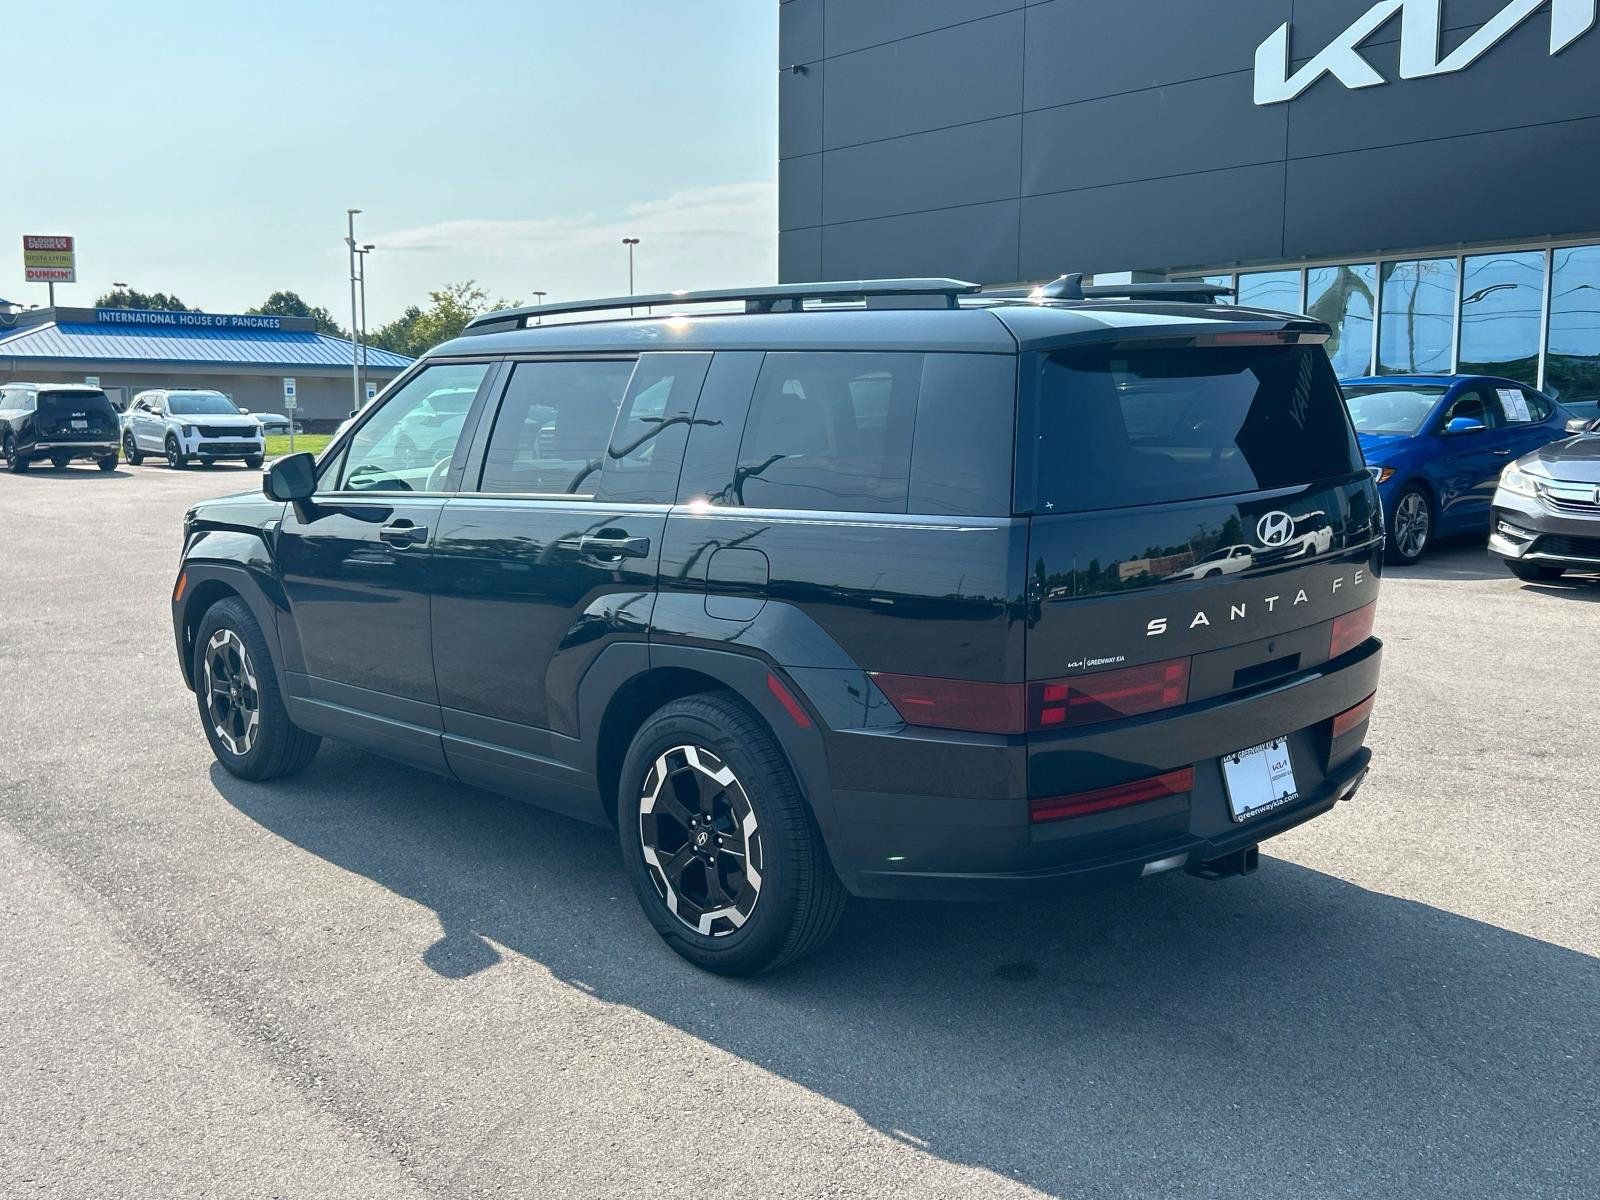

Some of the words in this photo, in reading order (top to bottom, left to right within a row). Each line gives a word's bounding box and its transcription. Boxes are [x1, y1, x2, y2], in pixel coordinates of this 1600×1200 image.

[1254, 0, 1597, 105] KIA
[98, 311, 177, 325] INTERNATIONAL
[179, 315, 212, 326] HOUSE
[215, 316, 228, 326] OF
[232, 317, 280, 329] PANCAKES
[1146, 589, 1308, 636] SANTA
[1331, 569, 1363, 593] FE
[1086, 657, 1115, 666] GREENWAY
[1238, 793, 1299, 822] greenwaykia.com
